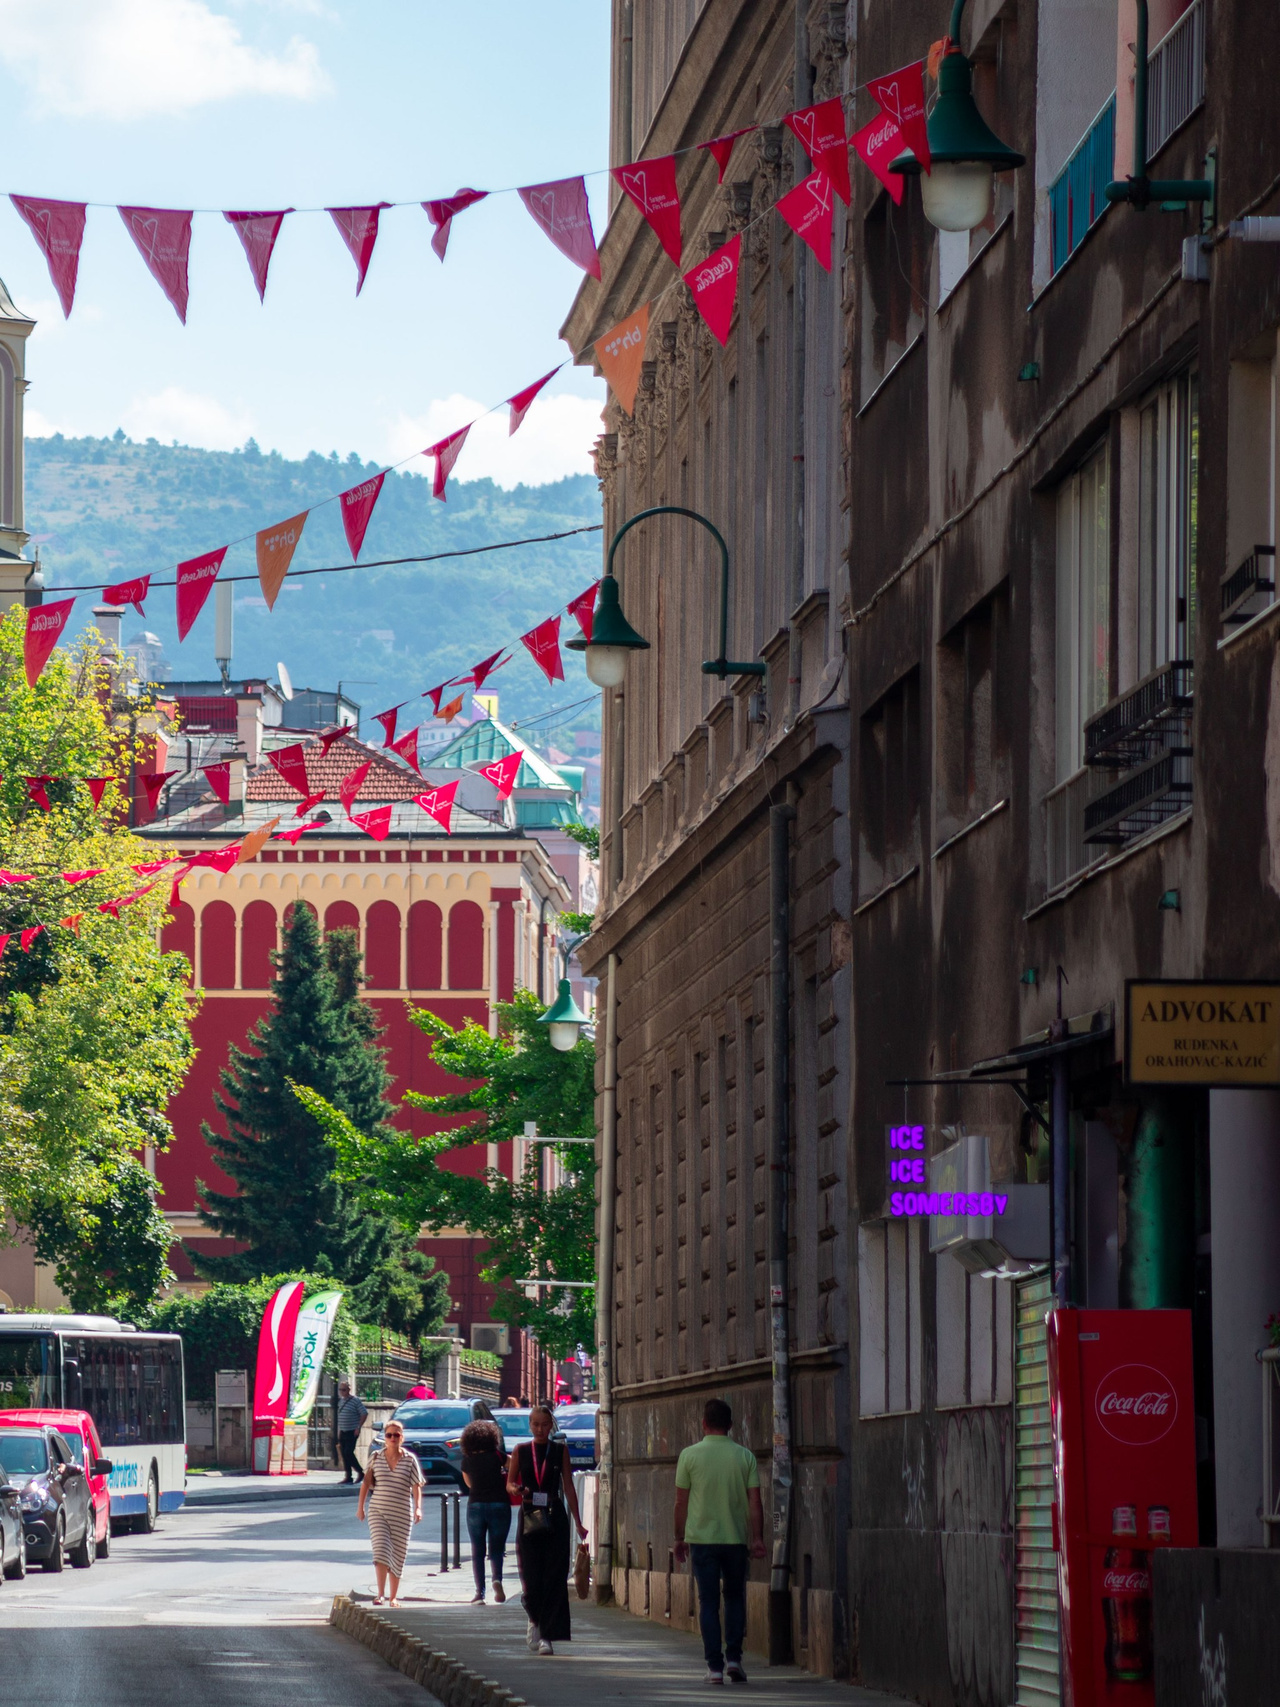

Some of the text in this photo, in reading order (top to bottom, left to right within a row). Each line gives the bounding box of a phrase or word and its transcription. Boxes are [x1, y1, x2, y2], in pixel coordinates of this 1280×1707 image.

[1141, 1000, 1272, 1022] ADVOKAT
[1173, 1039, 1239, 1051] RUDENKA
[890, 1125, 925, 1150] ICE
[890, 1158, 925, 1183] ICE
[1100, 1392, 1171, 1415] Coca-Cola
